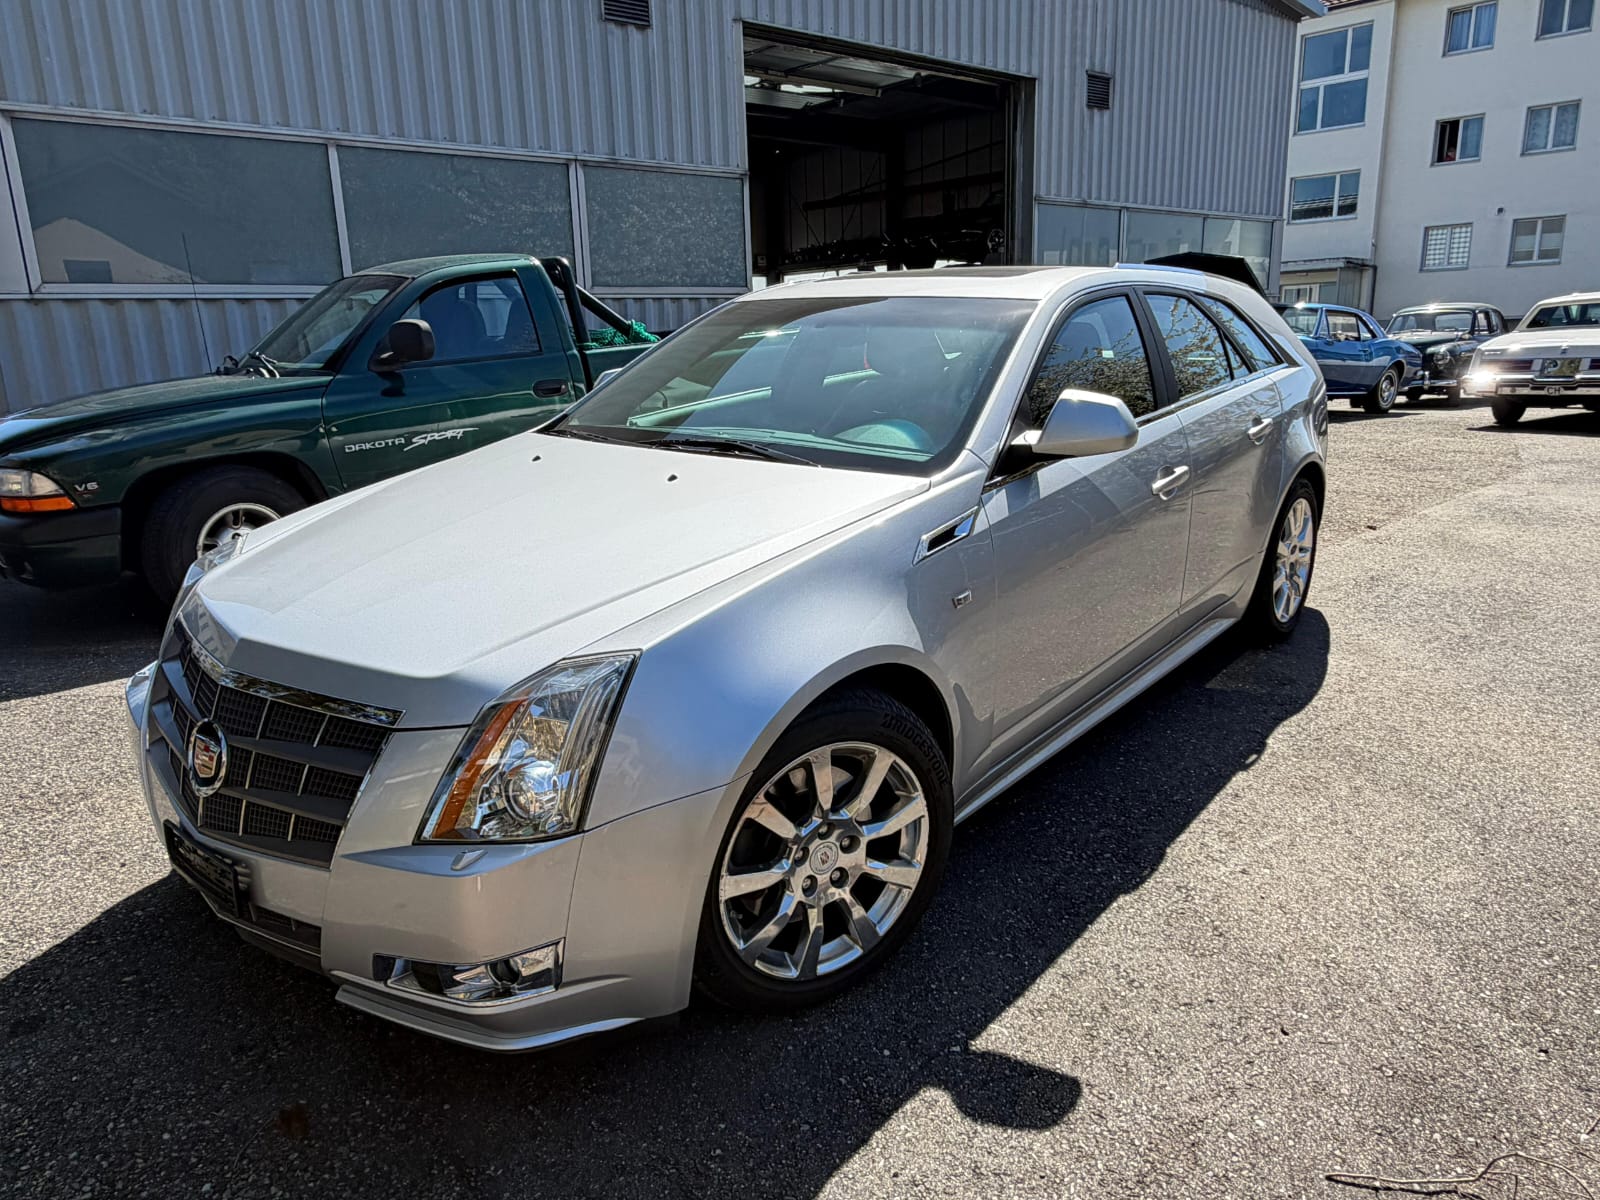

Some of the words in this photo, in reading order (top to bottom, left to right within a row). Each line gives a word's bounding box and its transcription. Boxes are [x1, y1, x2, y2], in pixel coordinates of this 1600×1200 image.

[344, 437, 405, 453] DAKOTA
[403, 427, 479, 452] SPORT
[74, 481, 99, 491] V6
[880, 712, 949, 785] BRIDGESTONE
